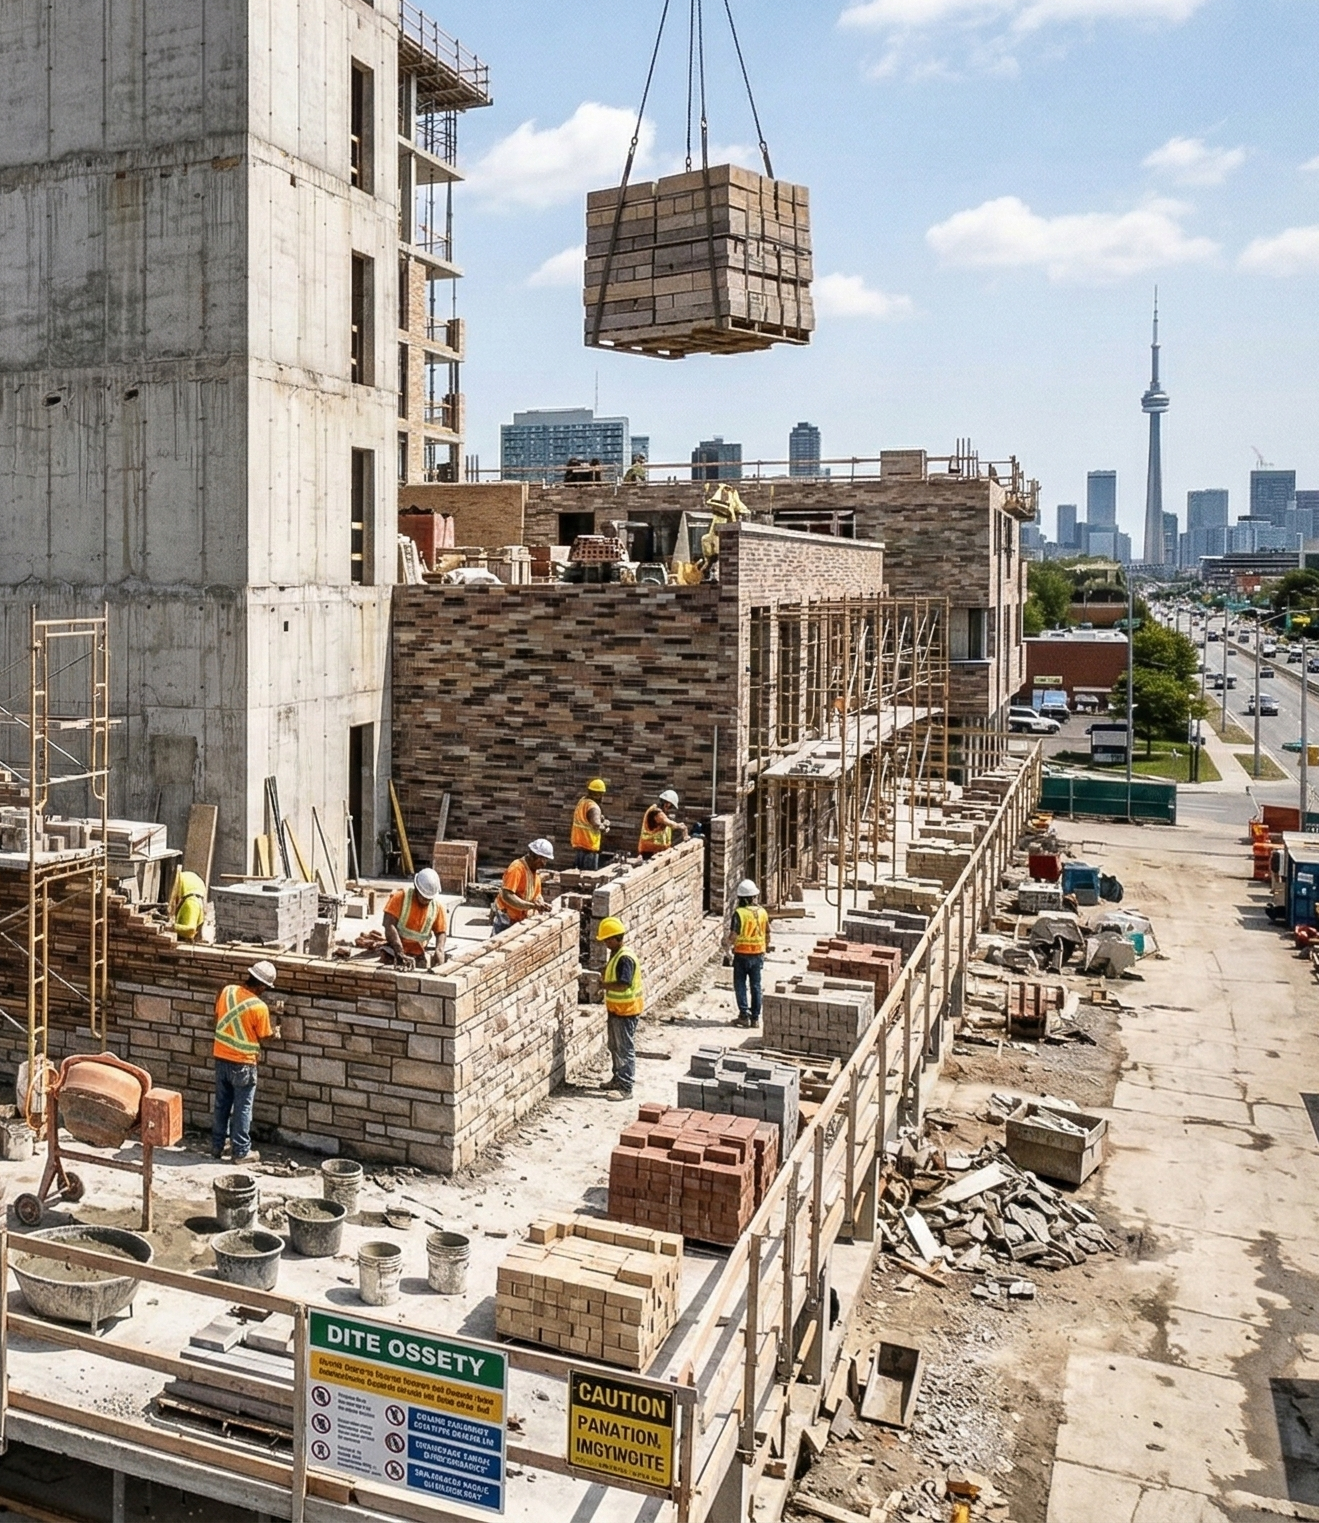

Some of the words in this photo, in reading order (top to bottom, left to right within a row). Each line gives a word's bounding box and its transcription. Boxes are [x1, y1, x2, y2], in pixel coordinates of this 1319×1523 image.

[327, 1324, 381, 1353] DITE
[388, 1339, 485, 1377] OSSETY
[579, 1383, 665, 1418] CAUTION
